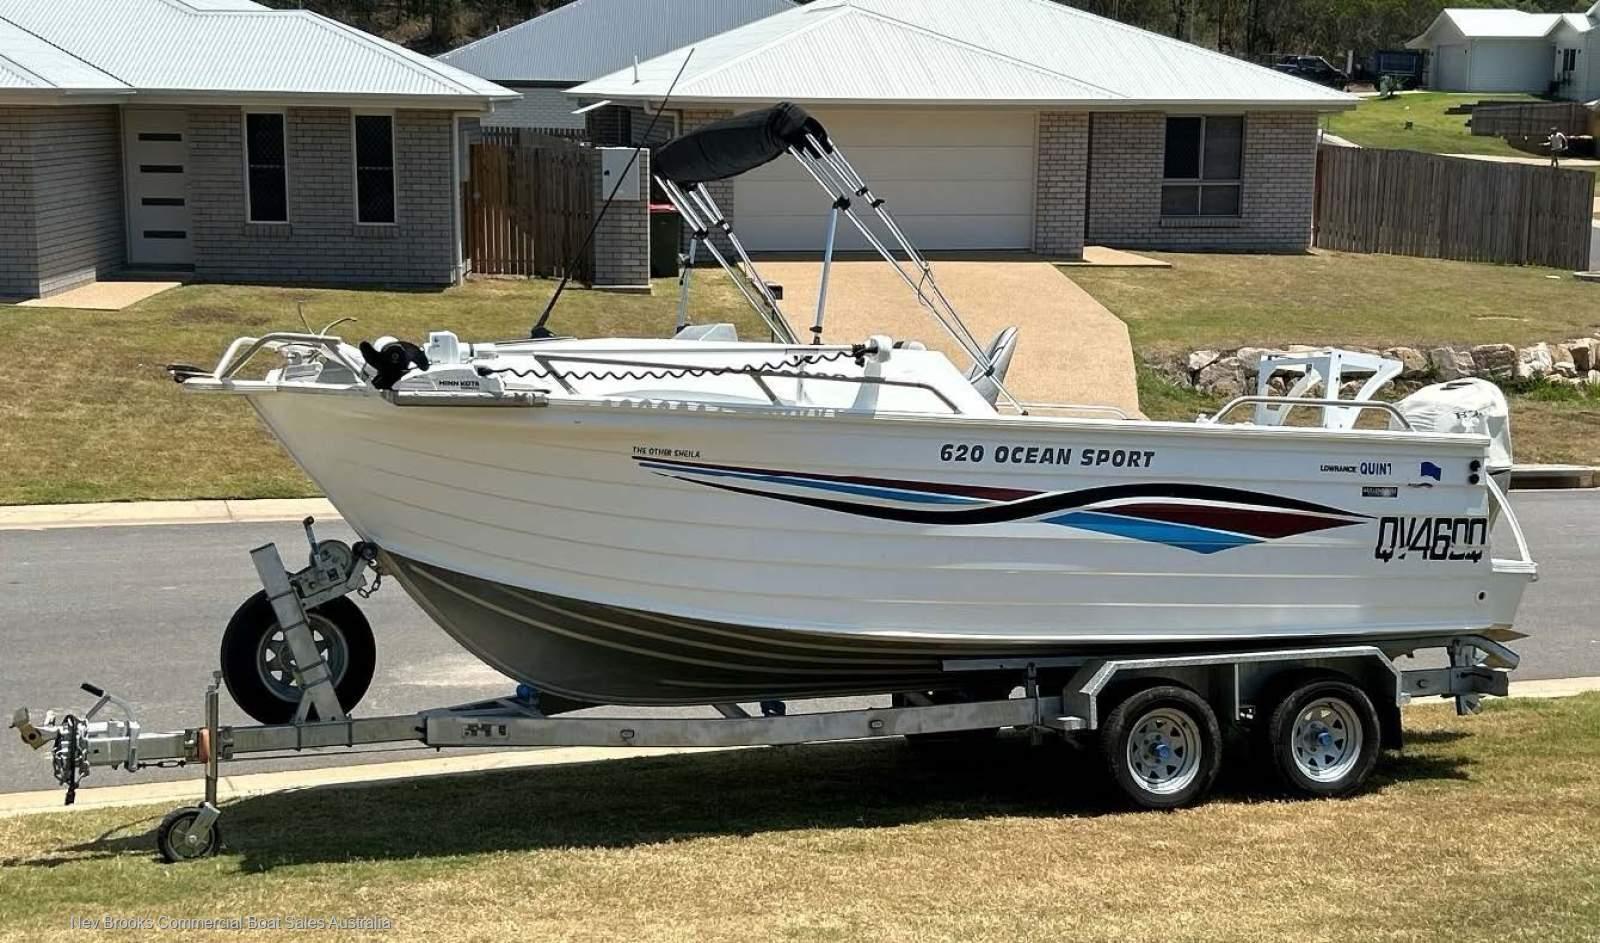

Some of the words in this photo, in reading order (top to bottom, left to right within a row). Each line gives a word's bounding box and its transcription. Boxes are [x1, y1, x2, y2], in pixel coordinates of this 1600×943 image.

[940, 443, 985, 463] 620
[994, 445, 1072, 465] OCEAN
[1080, 447, 1156, 468] SPORT
[1320, 464, 1358, 473] LOWRANCE
